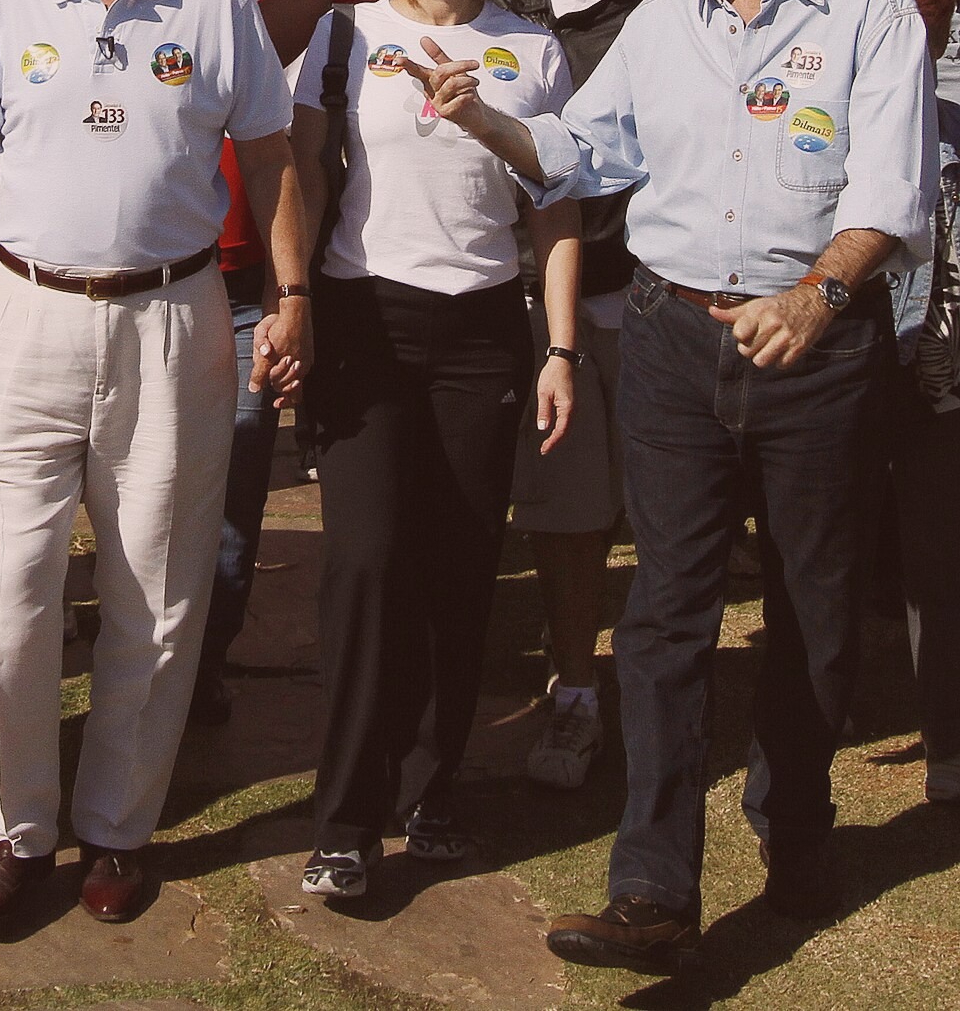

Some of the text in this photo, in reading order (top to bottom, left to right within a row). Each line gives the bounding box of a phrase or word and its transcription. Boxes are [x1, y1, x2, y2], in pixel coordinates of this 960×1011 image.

[486, 55, 518, 68] Dilma13
[801, 55, 822, 71] 133
[102, 108, 125, 123] 133
[91, 124, 120, 132] Pimentel
[793, 117, 832, 137] Dilma13
